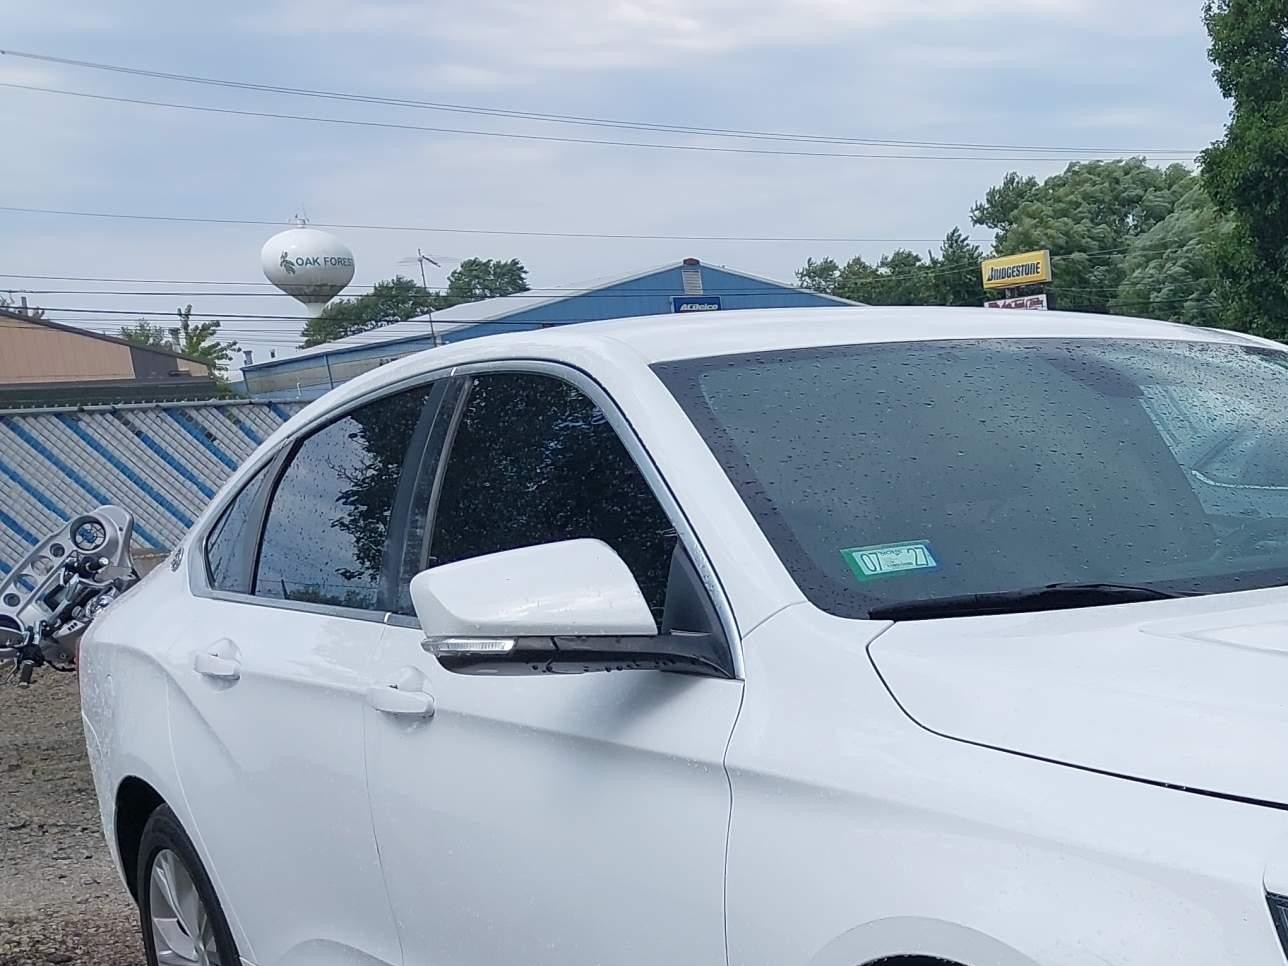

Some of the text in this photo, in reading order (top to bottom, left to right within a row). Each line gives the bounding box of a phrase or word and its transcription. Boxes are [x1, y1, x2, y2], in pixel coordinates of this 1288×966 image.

[295, 256, 354, 267] OAK FORES
[987, 261, 1041, 281] BRIDGESTONE
